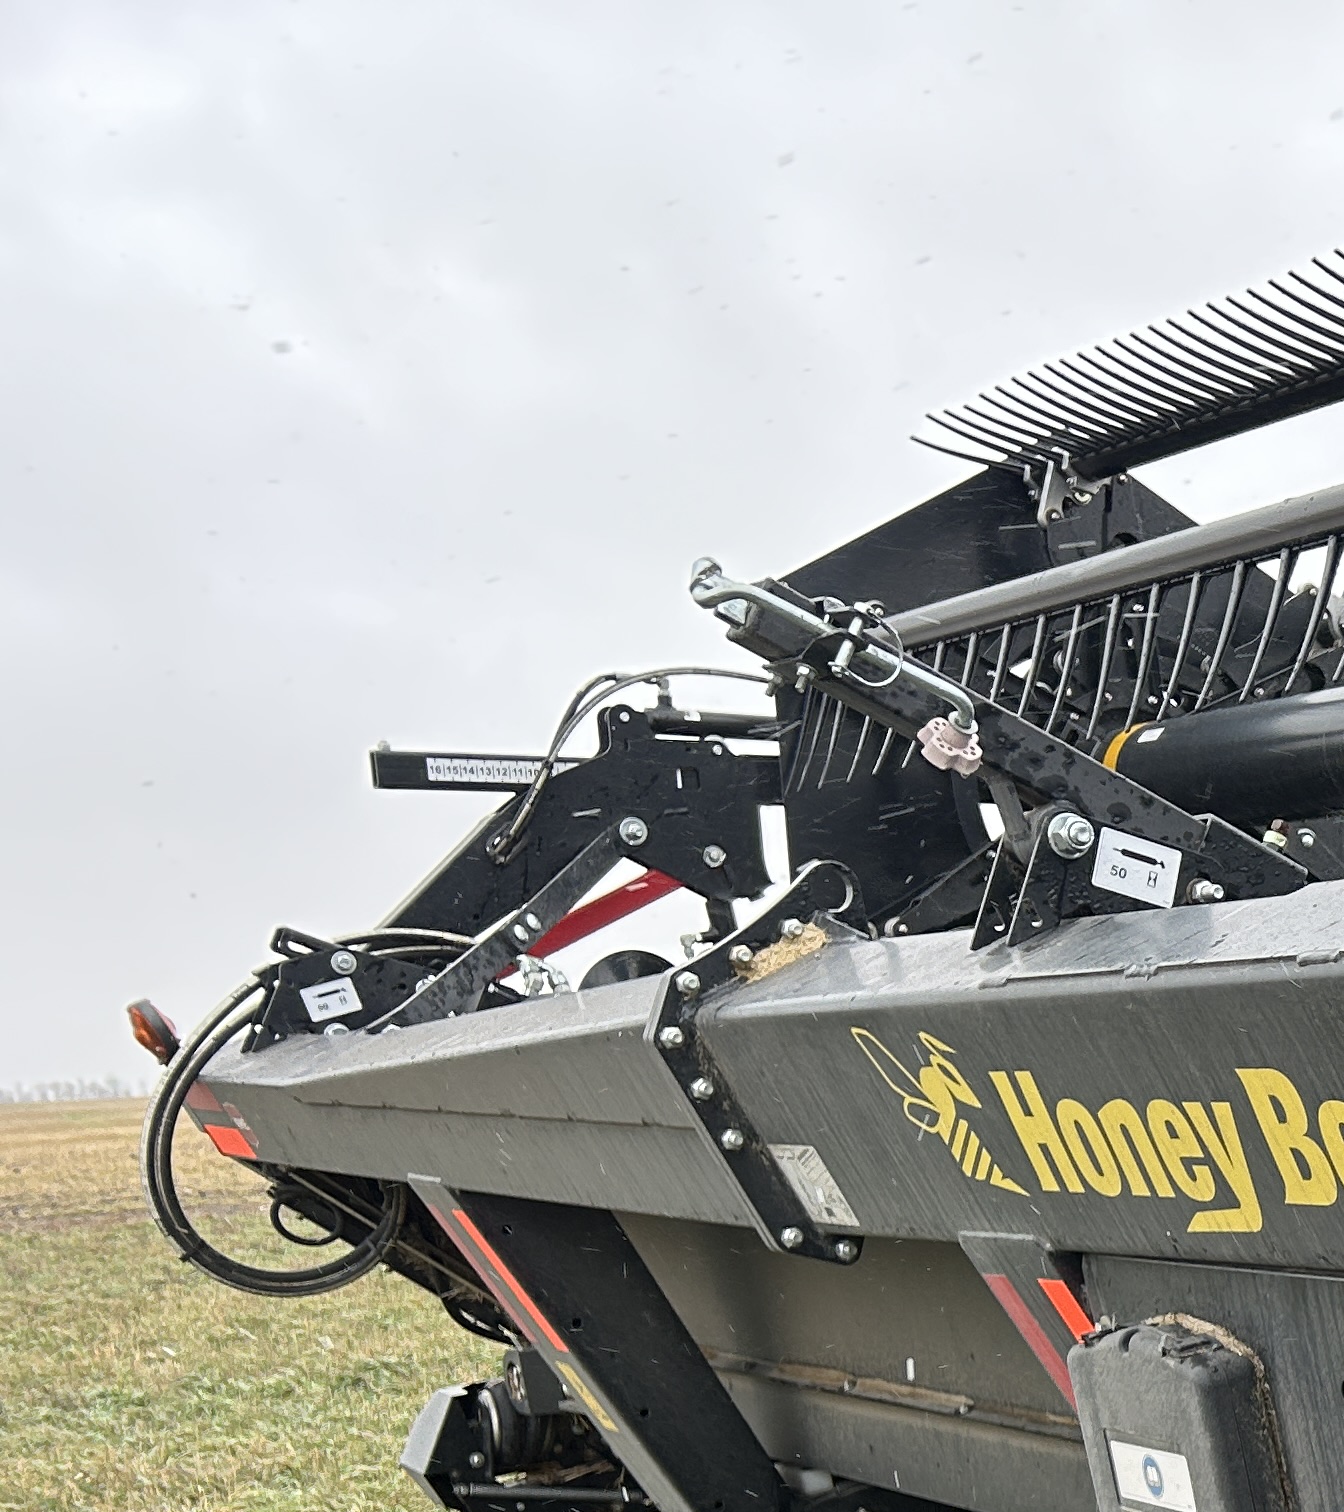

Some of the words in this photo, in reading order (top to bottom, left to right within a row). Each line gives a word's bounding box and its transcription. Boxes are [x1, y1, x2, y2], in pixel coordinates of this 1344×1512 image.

[429, 765, 442, 775] 16
[446, 765, 459, 776] 15
[462, 766, 475, 776] 14
[479, 766, 492, 776] 13
[496, 766, 508, 777] 12
[511, 766, 524, 776] 11
[1110, 864, 1128, 879] 50
[988, 1070, 1263, 1233] Honey
